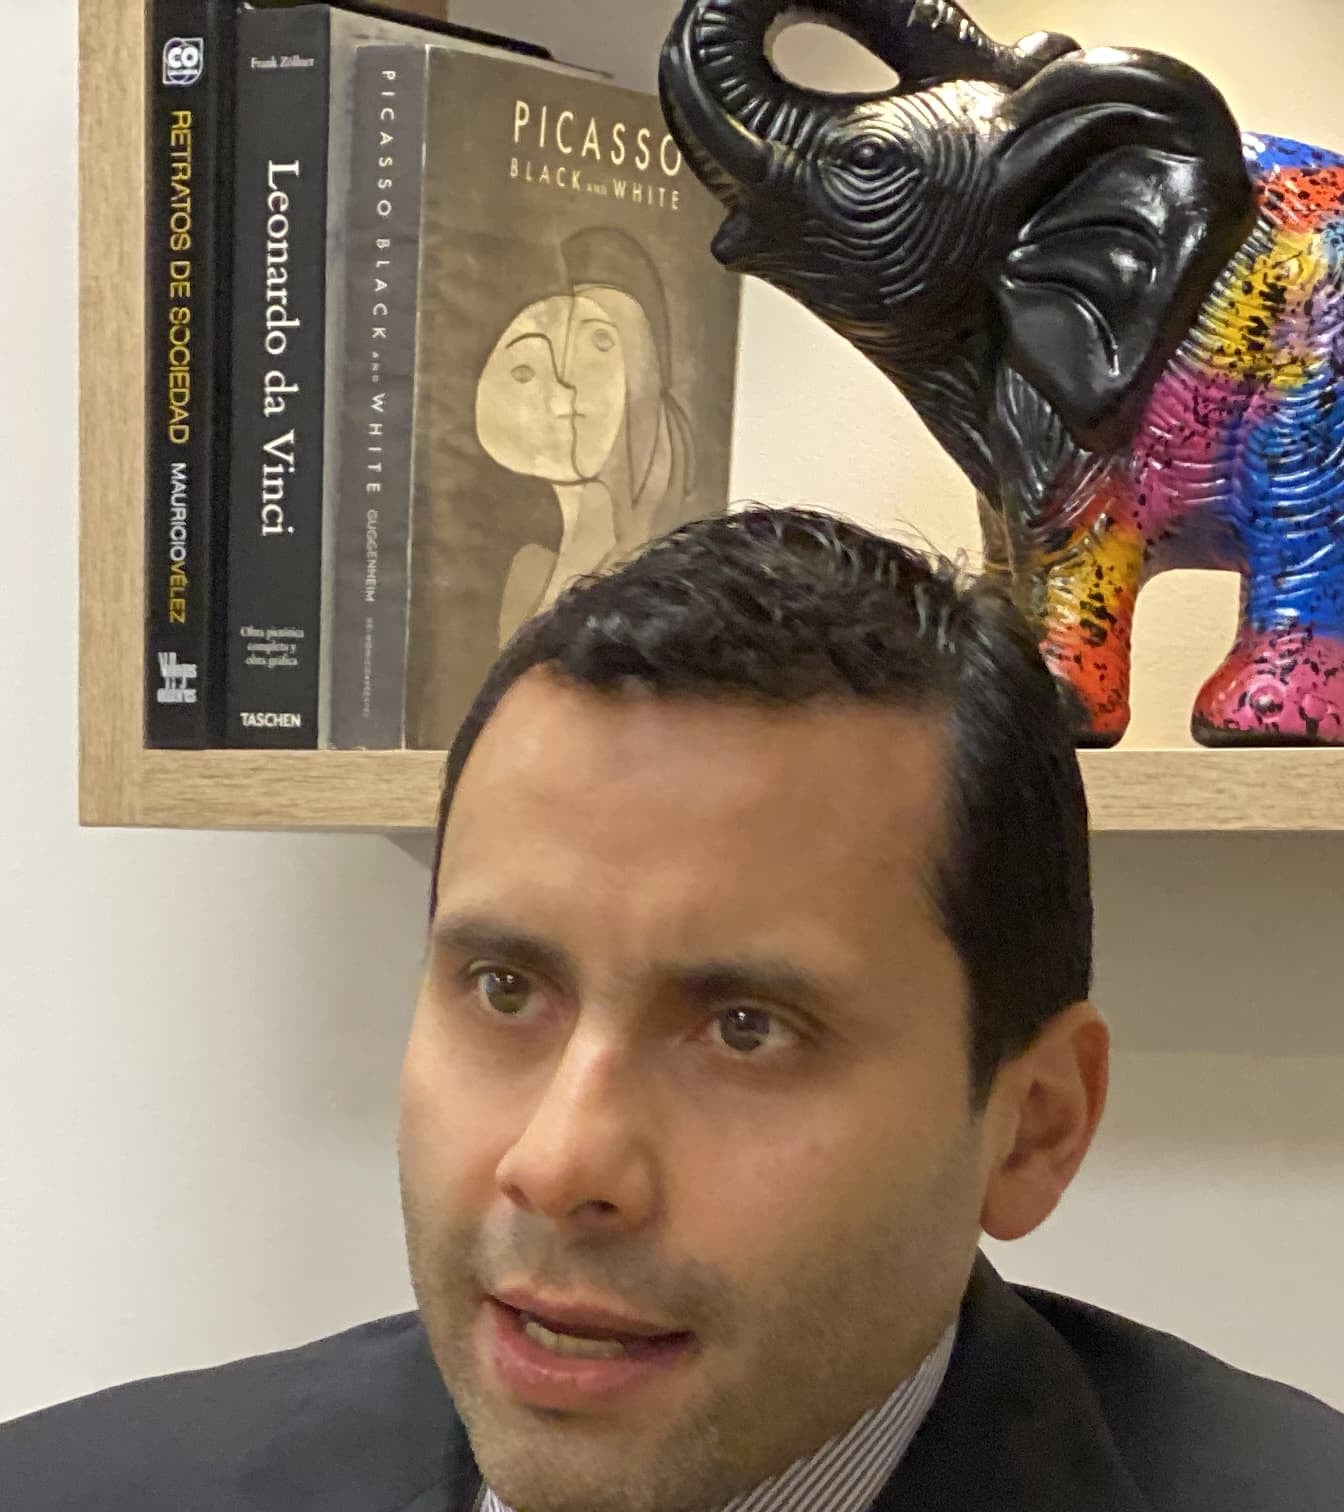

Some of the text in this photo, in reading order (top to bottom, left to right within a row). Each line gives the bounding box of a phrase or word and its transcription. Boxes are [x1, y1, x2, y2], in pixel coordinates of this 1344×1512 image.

[376, 70, 396, 217] PICASSO
[509, 157, 582, 191] BLACK
[612, 178, 681, 211] WHITE
[513, 99, 683, 177] PICASSO
[168, 109, 193, 445] RETRATOS DE SOCIEDAD
[372, 238, 391, 339] BLACK
[261, 160, 300, 537] Leonardo da Vinci
[366, 392, 386, 493] WHITE
[365, 508, 379, 602] GUGGENHEIM
[239, 712, 302, 728] TASCHEN
